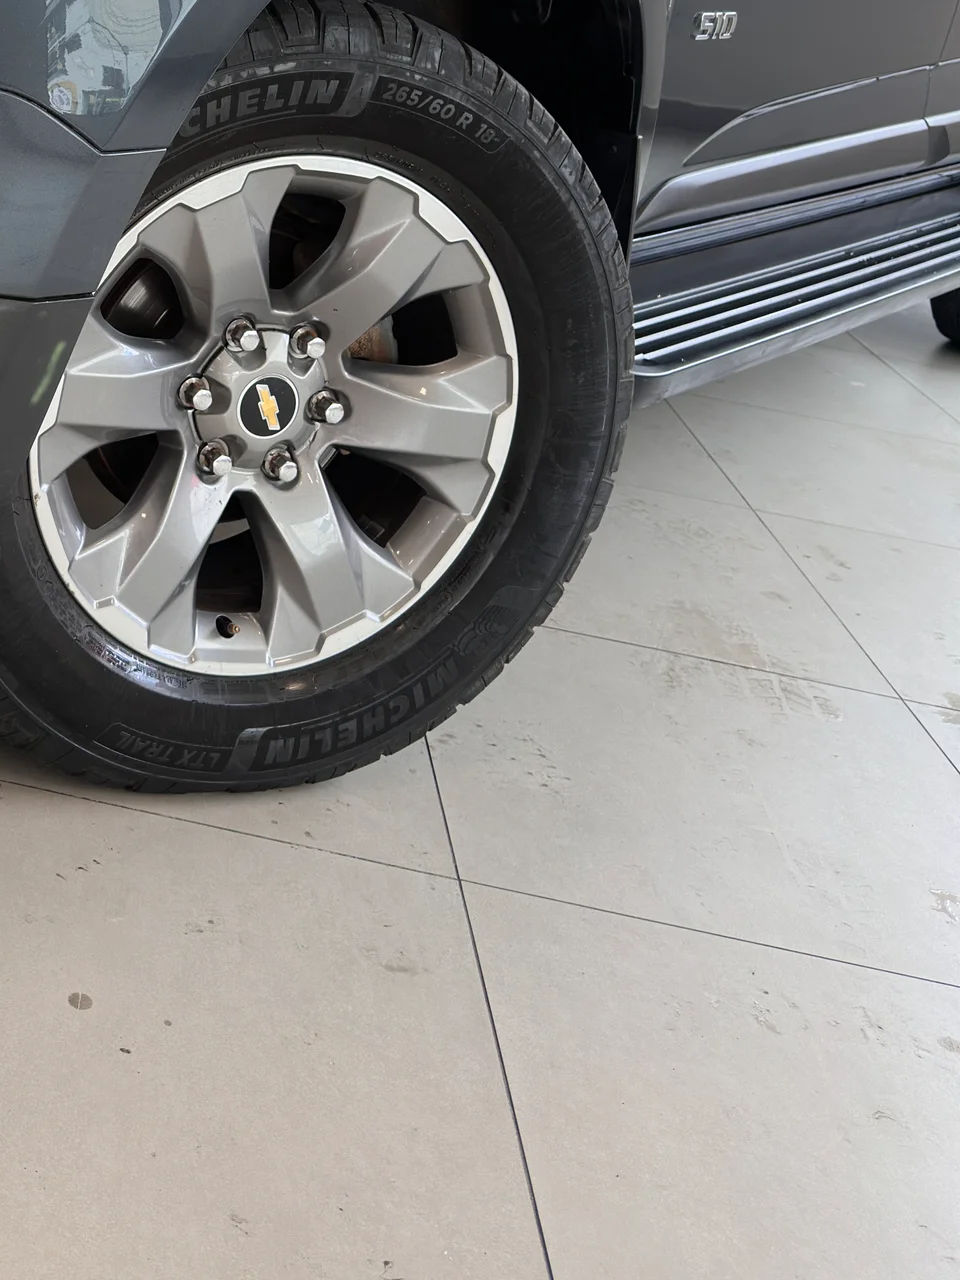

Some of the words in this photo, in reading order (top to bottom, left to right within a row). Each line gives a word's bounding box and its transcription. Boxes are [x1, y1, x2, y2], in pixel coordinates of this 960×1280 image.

[693, 11, 738, 41] S10
[381, 82, 457, 120] 265/60
[455, 111, 475, 131] R
[474, 122, 498, 145] 18
[263, 654, 460, 766] MICHELIN
[115, 730, 175, 762] TRAIL
[173, 748, 223, 770] LTX
